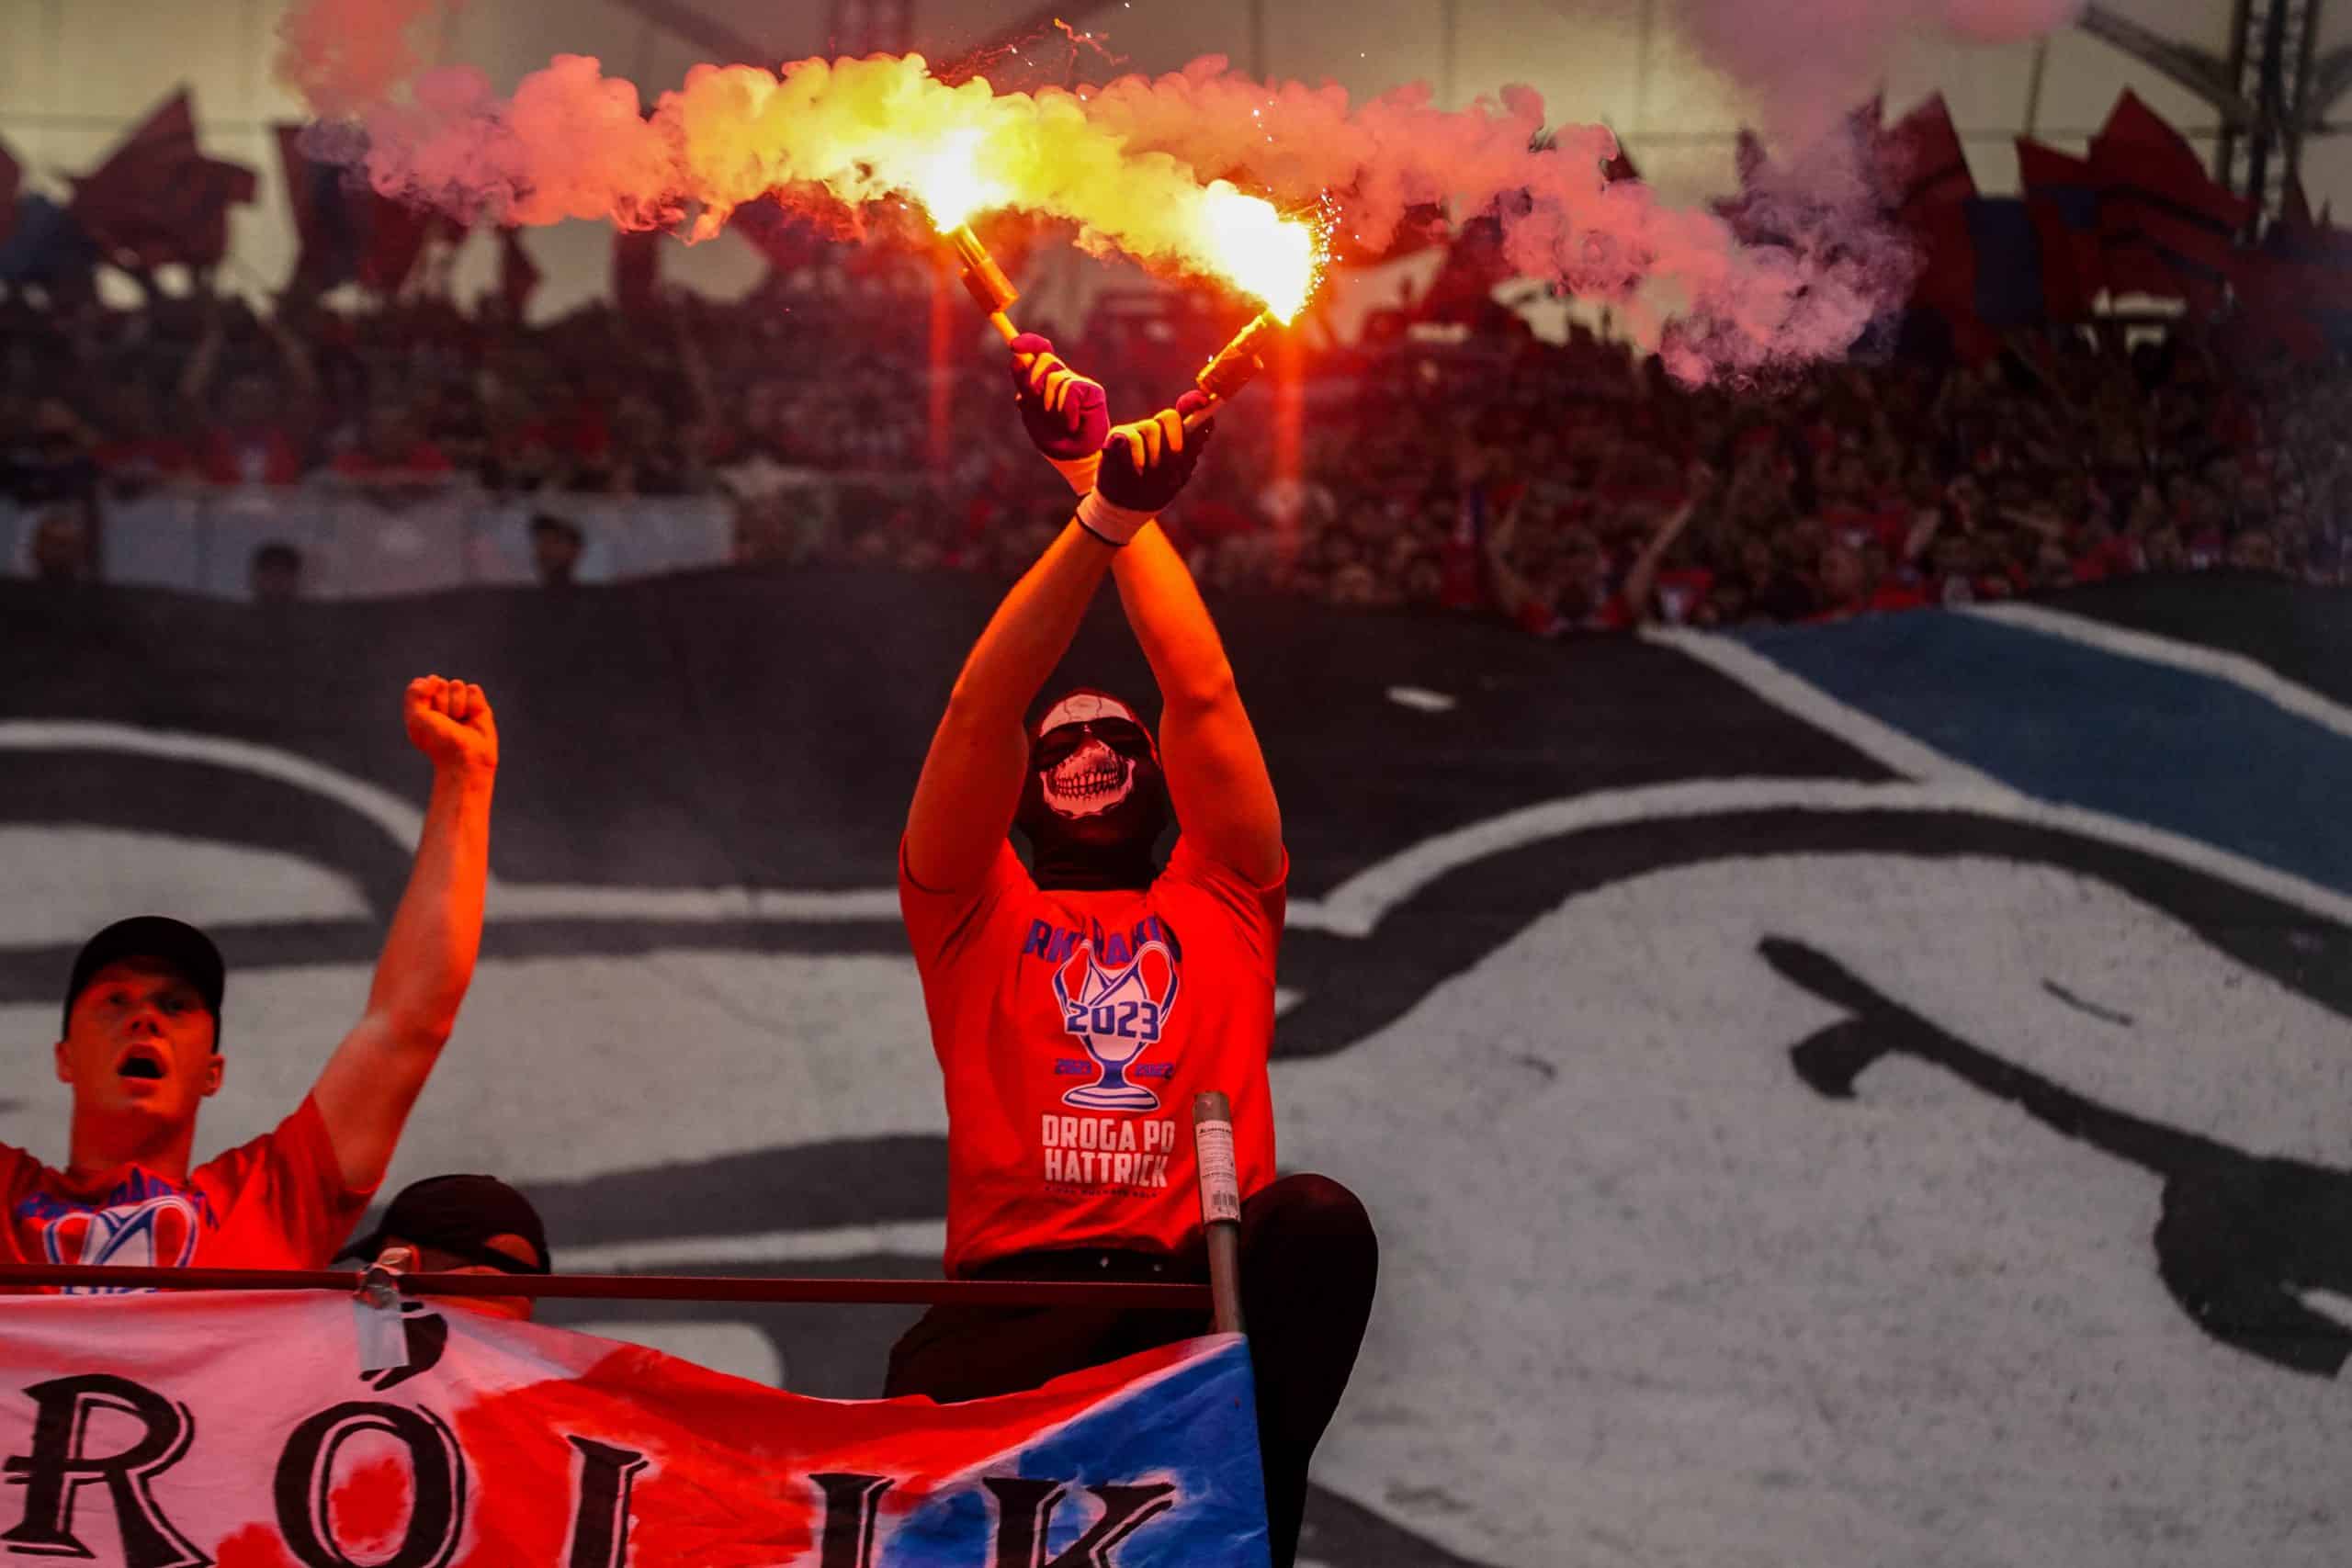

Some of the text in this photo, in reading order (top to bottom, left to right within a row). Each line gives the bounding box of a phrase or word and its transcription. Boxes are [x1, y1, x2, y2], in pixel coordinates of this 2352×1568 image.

[1066, 1000, 1160, 1041] 2023
[1042, 1114, 1176, 1153] DROGA PO
[1044, 1148, 1169, 1188] HATTRICK
